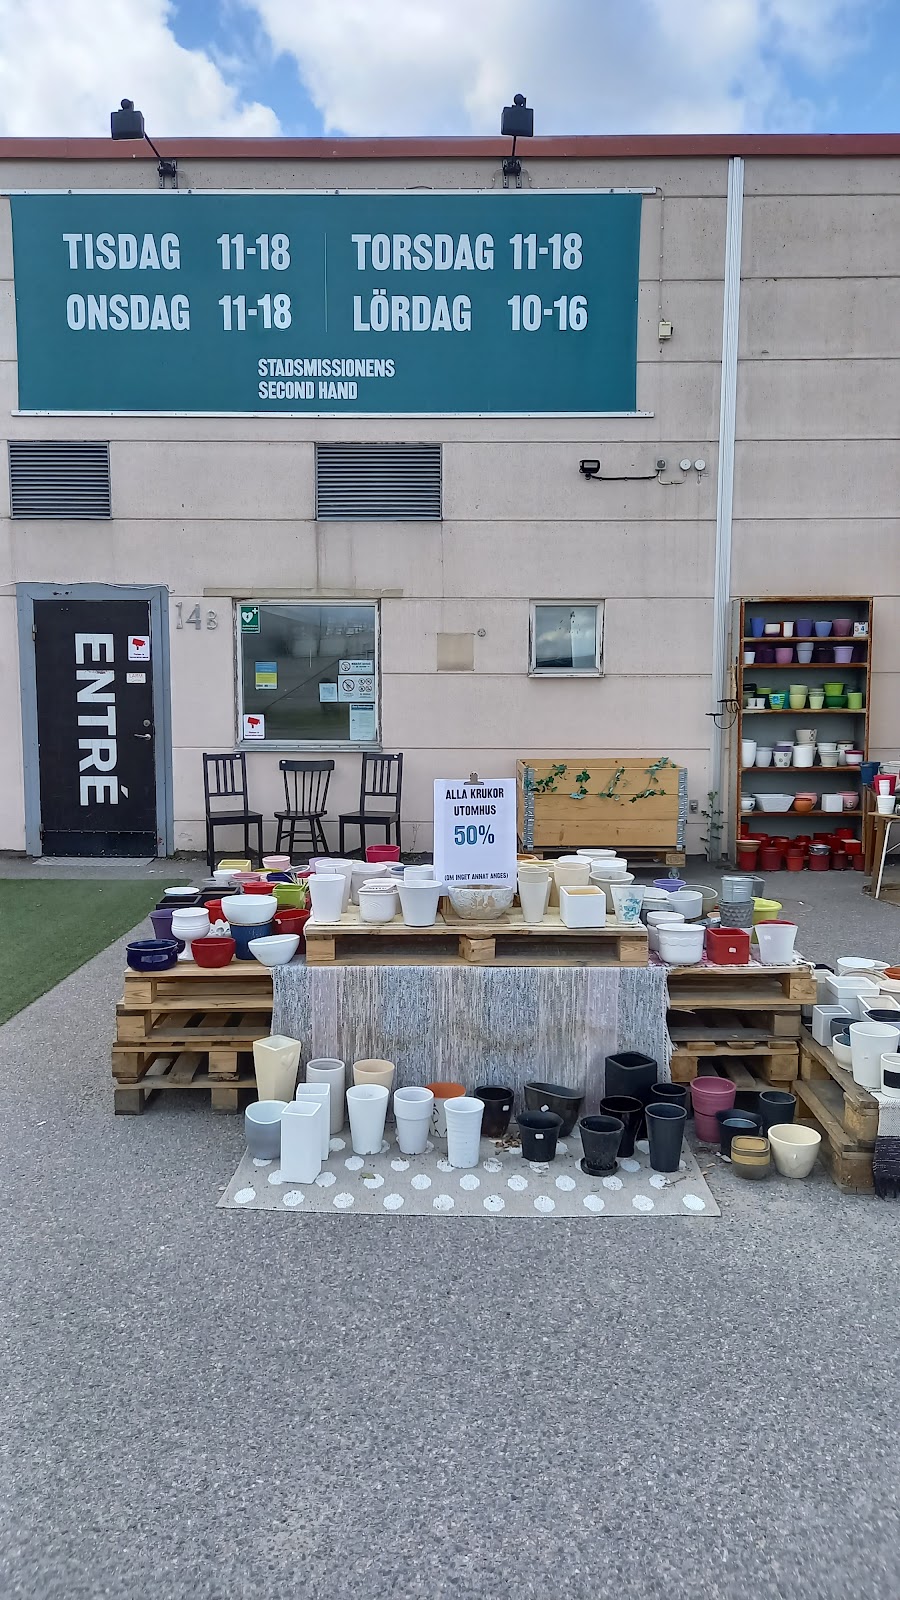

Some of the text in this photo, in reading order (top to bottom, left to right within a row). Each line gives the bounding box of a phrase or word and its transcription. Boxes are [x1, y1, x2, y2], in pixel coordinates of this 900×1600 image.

[63, 232, 291, 271] TISDAG 11-18
[351, 232, 583, 271] TORSDAG 11-18
[66, 294, 293, 332] ONSDAG 11-18
[353, 288, 588, 332] LÖRDAG 10-16
[257, 357, 396, 378] STADSMISSIONENS
[258, 381, 358, 400] SECOND HAND
[74, 633, 129, 806] ENTRÉ
[445, 788, 504, 800] ALLA KRUKOR
[453, 805, 497, 816] UTOMHUS
[454, 824, 495, 846] 50%
